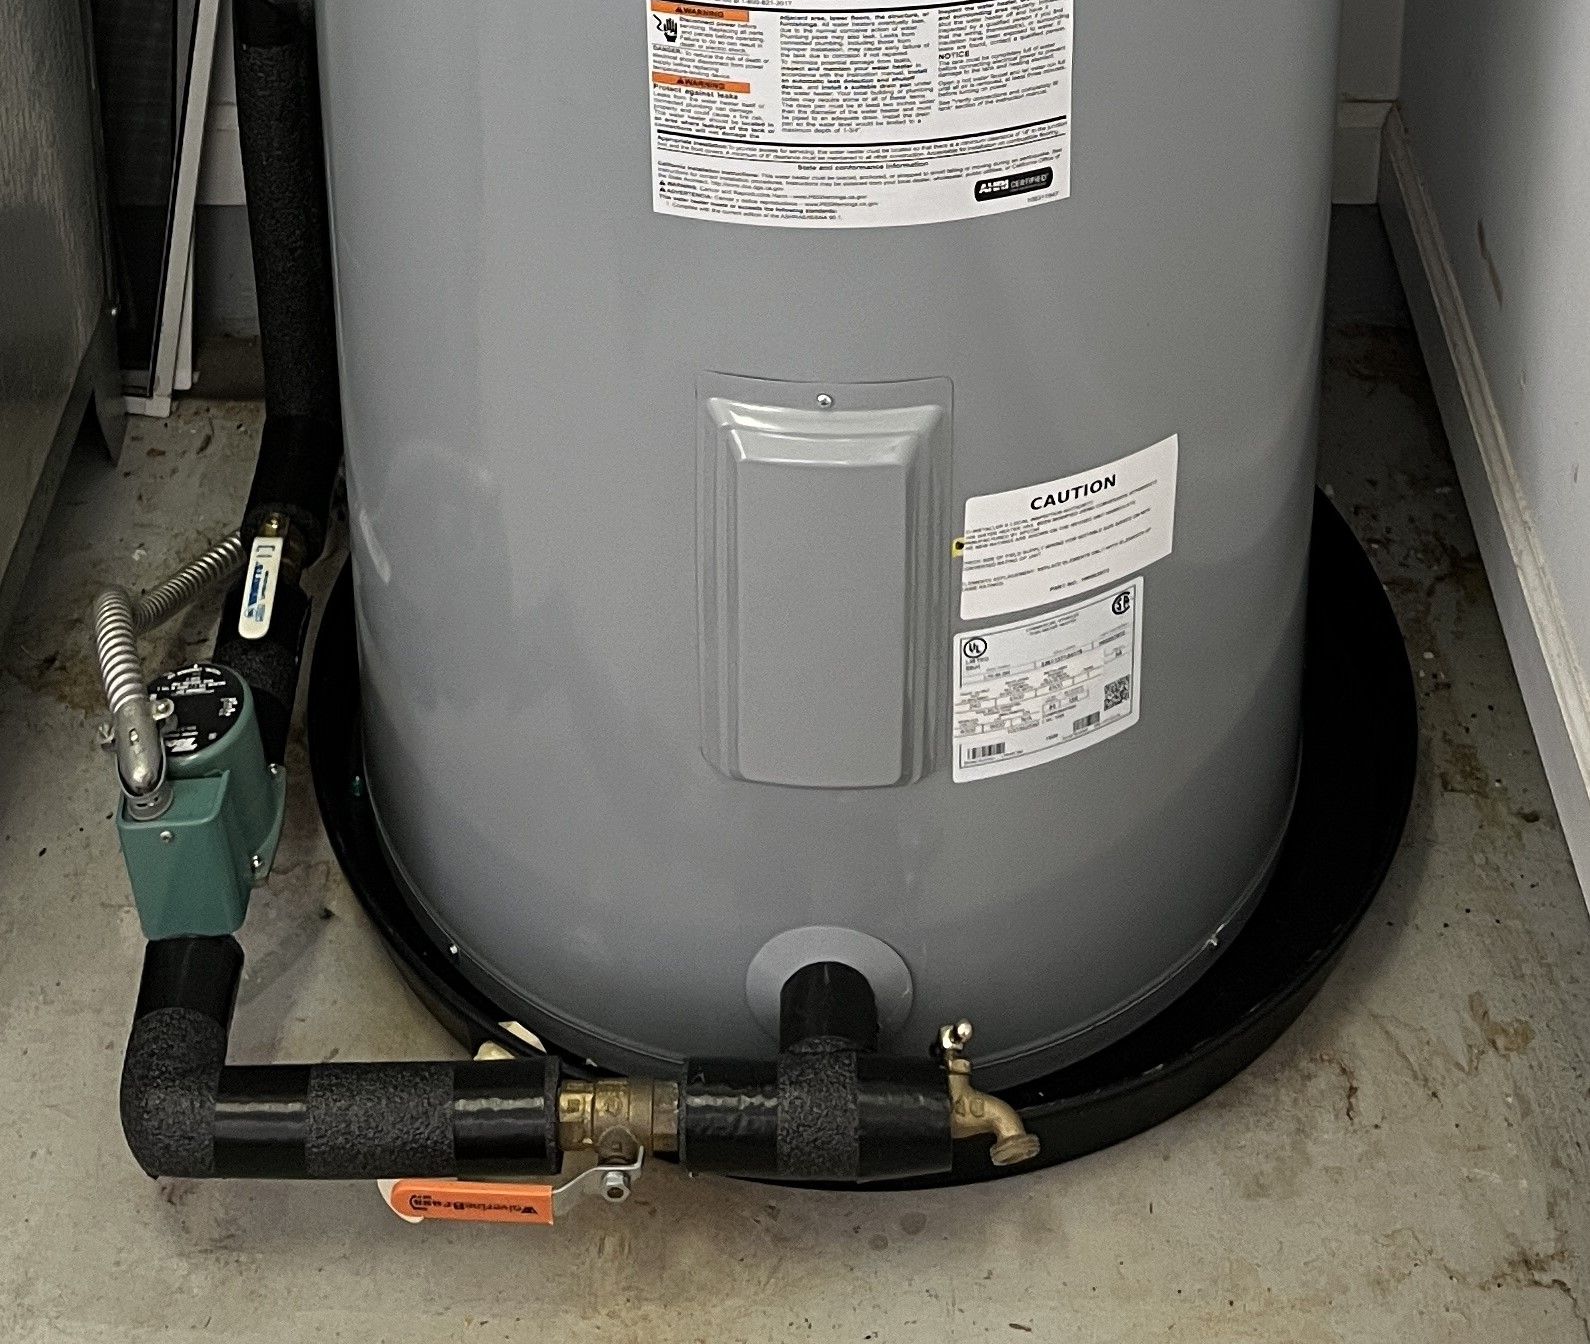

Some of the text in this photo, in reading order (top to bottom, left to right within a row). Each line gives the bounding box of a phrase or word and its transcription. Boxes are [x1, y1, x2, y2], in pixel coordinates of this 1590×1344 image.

[684, 8, 724, 18] WARNING
[939, 51, 969, 59] NOTICE
[1011, 174, 1046, 189] CERTIFIED
[1030, 474, 1116, 510] CAUTION
